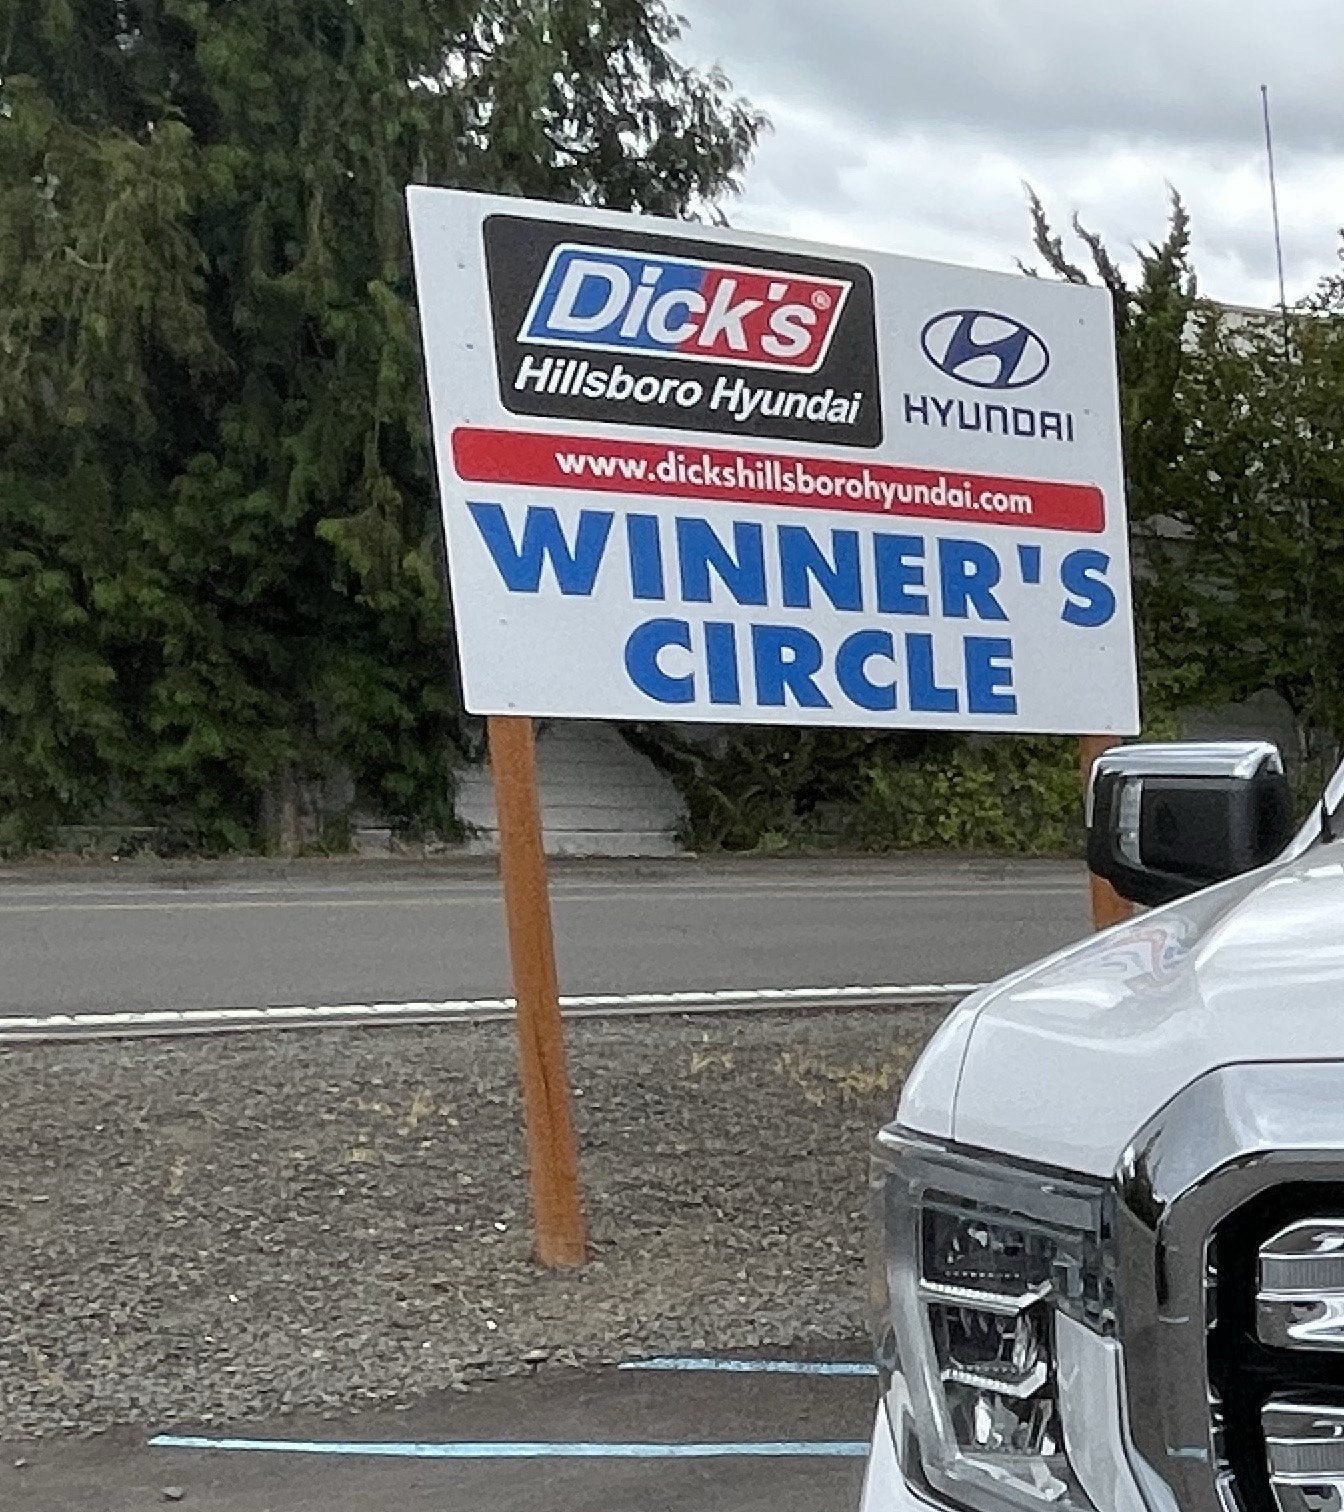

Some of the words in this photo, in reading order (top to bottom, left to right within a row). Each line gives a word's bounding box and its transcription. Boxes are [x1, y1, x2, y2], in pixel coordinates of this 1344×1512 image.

[546, 258, 822, 360] Dick's
[514, 354, 703, 408] Hillsboro
[709, 377, 862, 423] Hyundai
[904, 394, 1074, 441] HYUNDAI
[555, 449, 1033, 516] www.dickshillsborohyundai.com
[466, 501, 1116, 627] WINNER'S
[624, 617, 1019, 715] CIRCLE
